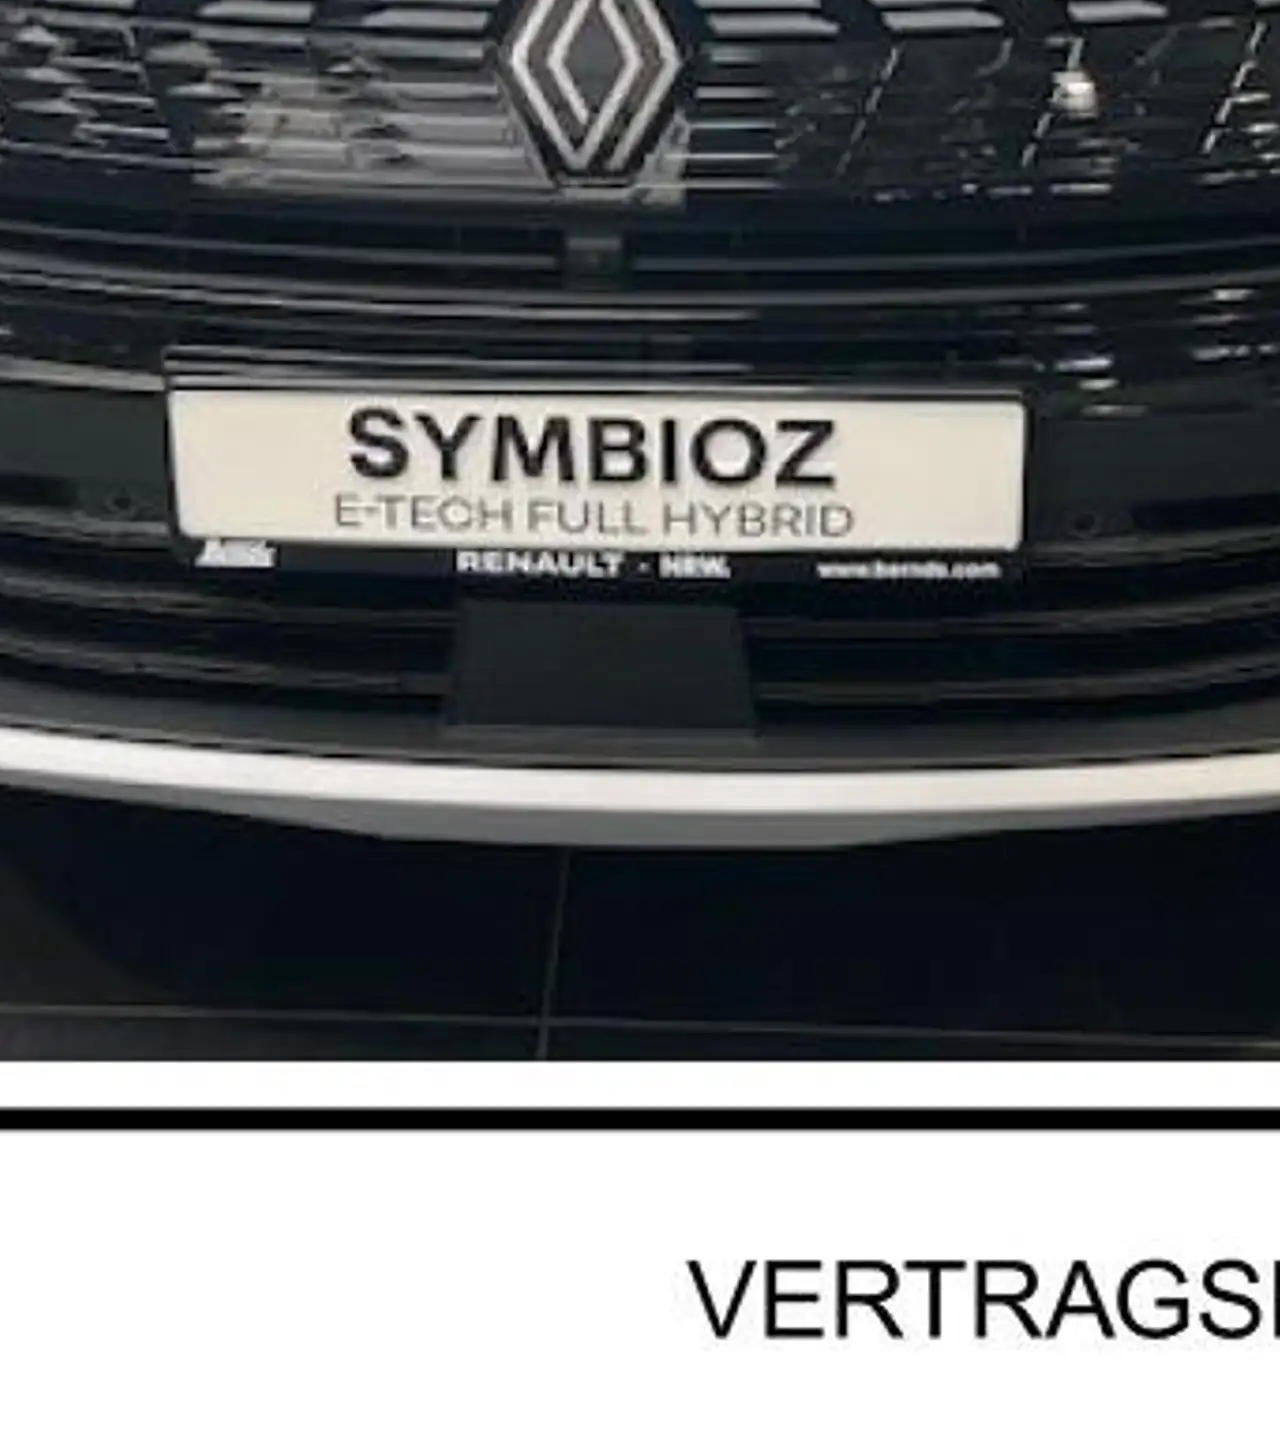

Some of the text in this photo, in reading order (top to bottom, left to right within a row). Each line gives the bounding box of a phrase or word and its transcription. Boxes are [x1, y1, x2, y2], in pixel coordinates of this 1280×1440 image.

[348, 406, 837, 489] SYMBIOZ
[334, 493, 855, 540] E-TECH FULL HYBRID
[456, 550, 624, 578] RENAULT
